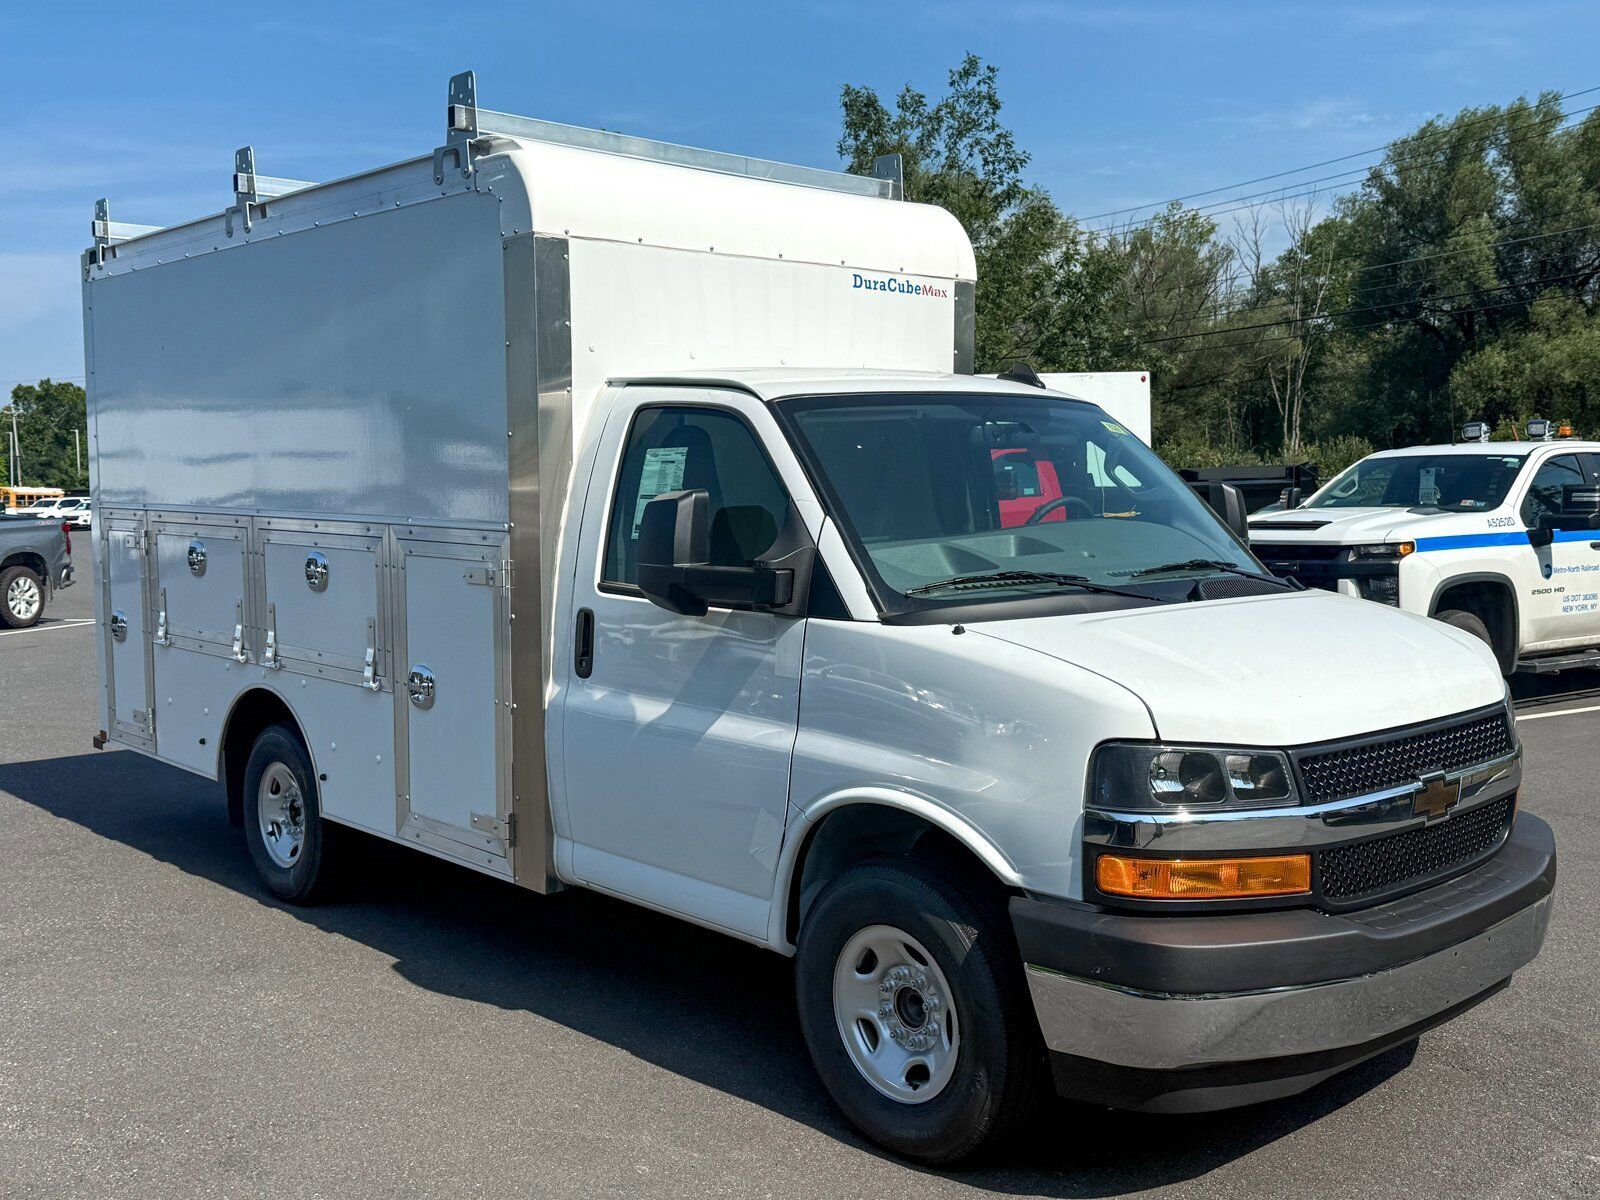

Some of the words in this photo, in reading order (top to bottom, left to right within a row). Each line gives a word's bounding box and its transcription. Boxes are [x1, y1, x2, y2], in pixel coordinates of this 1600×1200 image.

[852, 273, 948, 298] DuraCubeMax
[1553, 566, 1581, 574] Metro-North
[1581, 564, 1600, 572] Railroad
[1531, 588, 1552, 596] 2500
[1571, 594, 1581, 602] DOT
[1562, 605, 1574, 613] NEW
